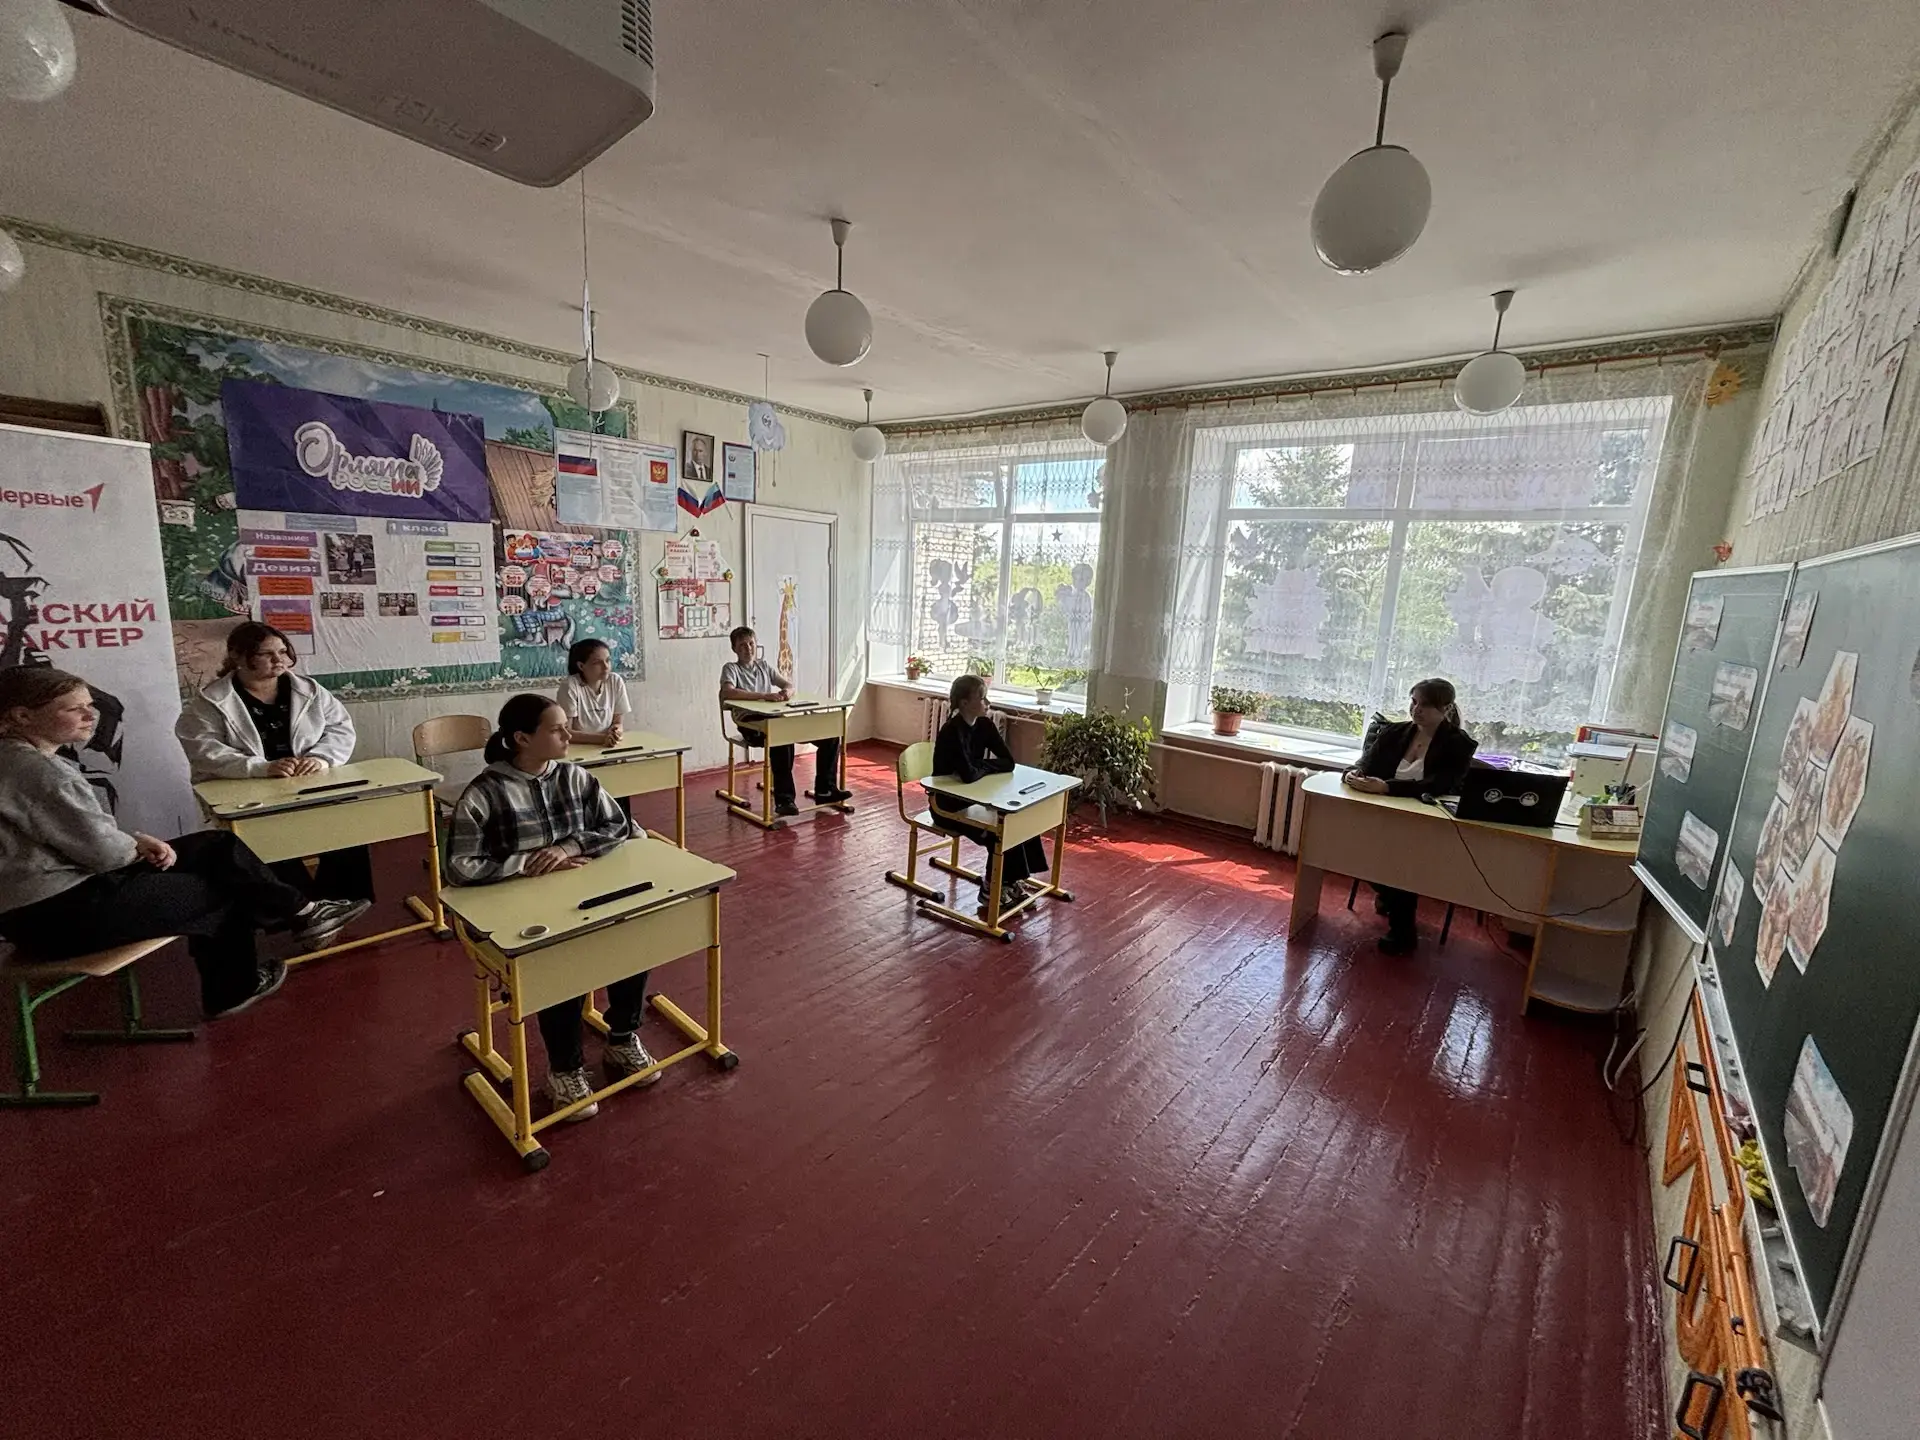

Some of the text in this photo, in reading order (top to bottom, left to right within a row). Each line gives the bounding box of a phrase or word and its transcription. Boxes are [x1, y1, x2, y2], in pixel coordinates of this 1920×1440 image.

[297, 424, 421, 480] Орлята
[334, 471, 421, 497] РОССИИ
[391, 522, 446, 533] 1 класс
[255, 532, 310, 542] Название:
[252, 562, 317, 573] Девиз:
[0, 598, 156, 626] СКИЙ
